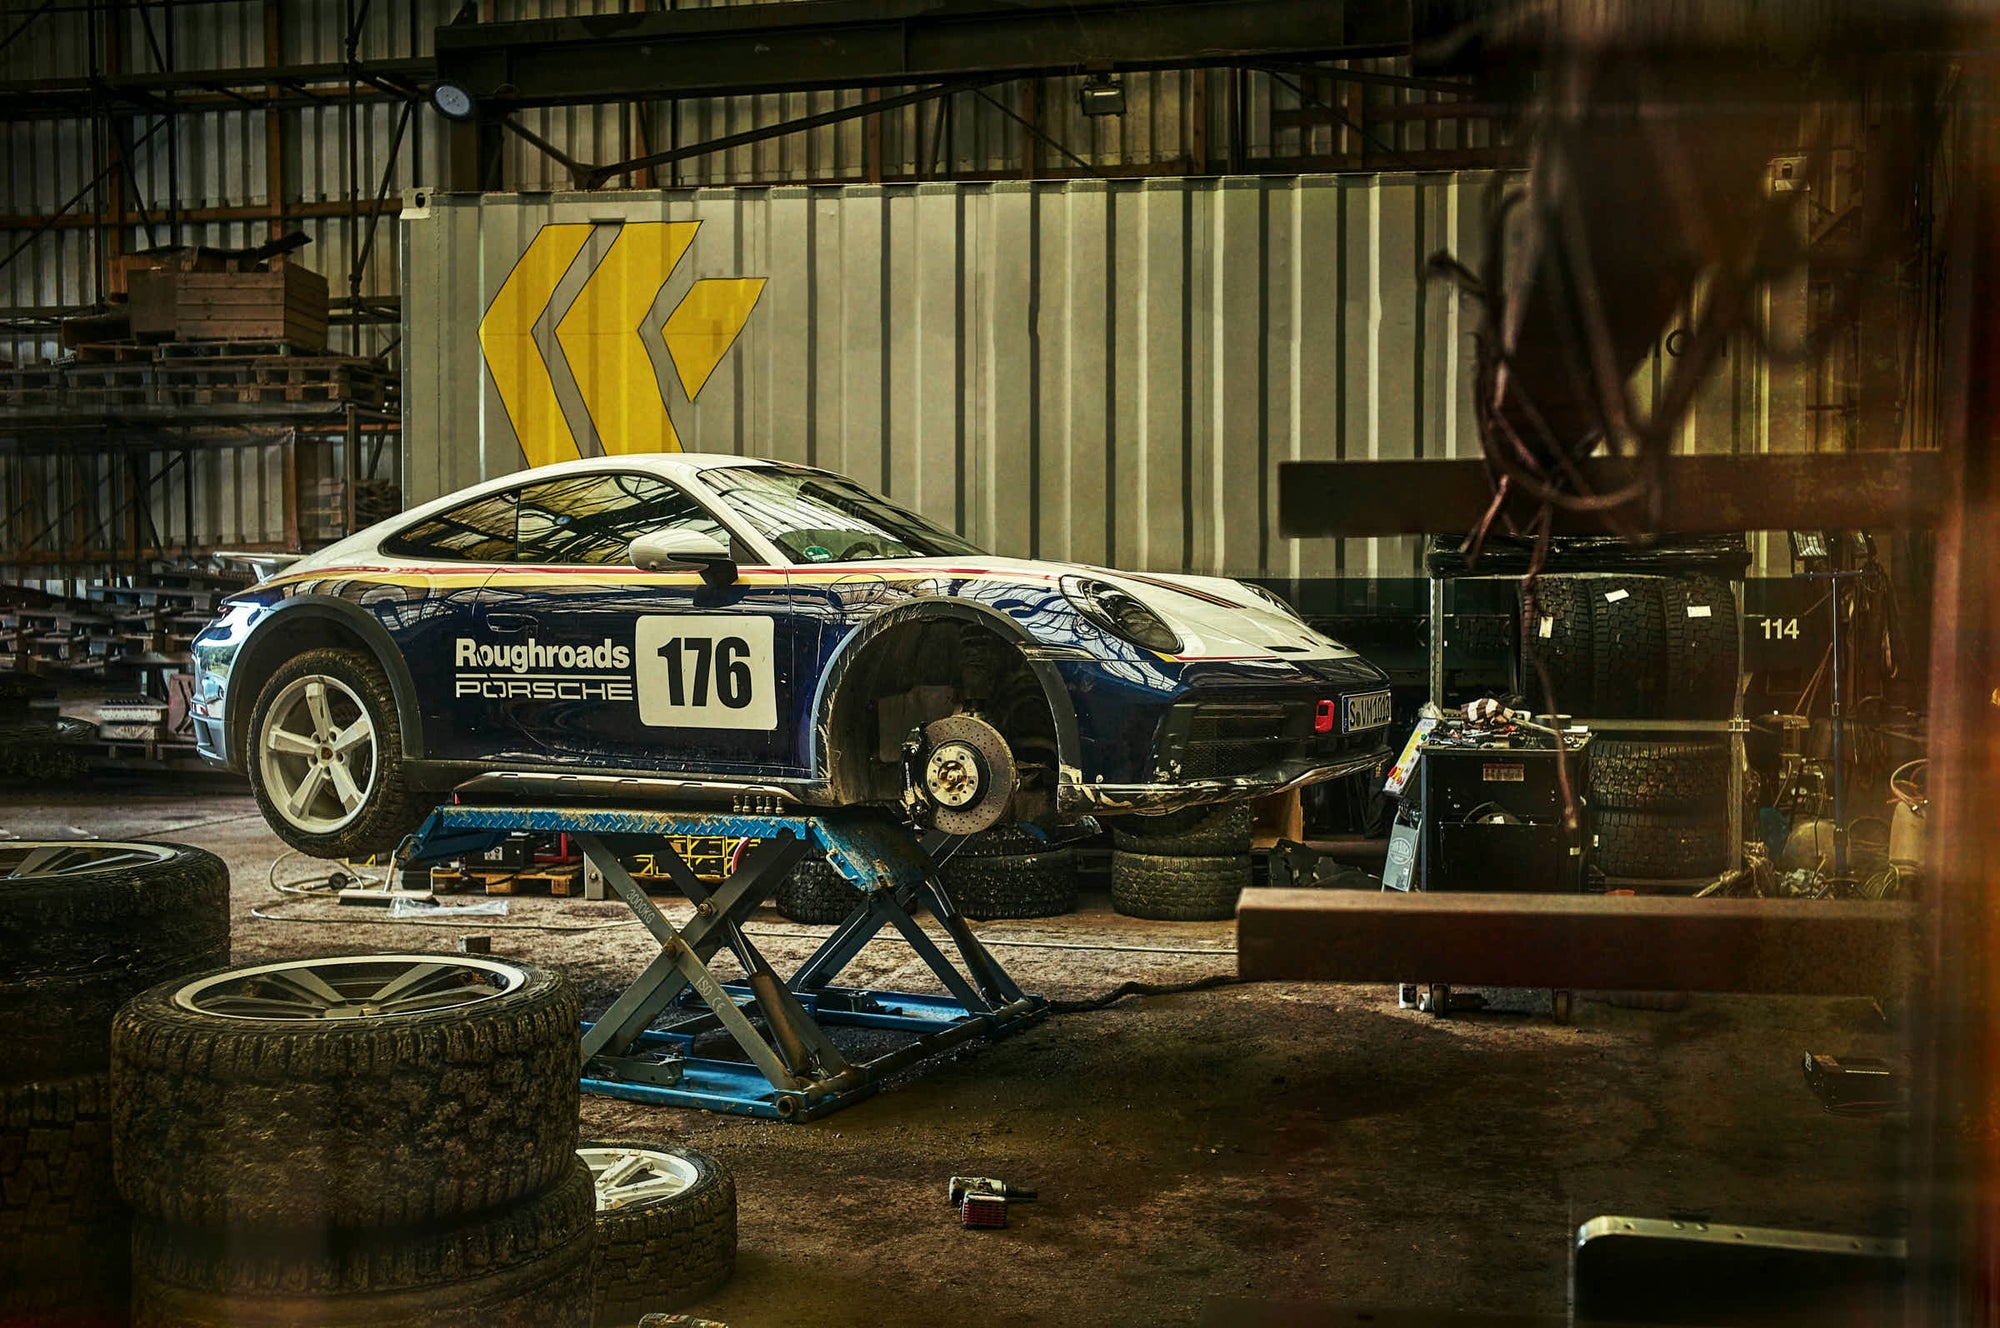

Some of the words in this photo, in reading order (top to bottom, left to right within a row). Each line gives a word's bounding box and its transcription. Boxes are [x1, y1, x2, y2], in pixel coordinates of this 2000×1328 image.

[1760, 618, 1800, 640] 114
[455, 638, 631, 674] Roughroads
[657, 636, 753, 709] 176
[455, 681, 634, 701] PORSCHE
[626, 889, 656, 924] 3000KG
